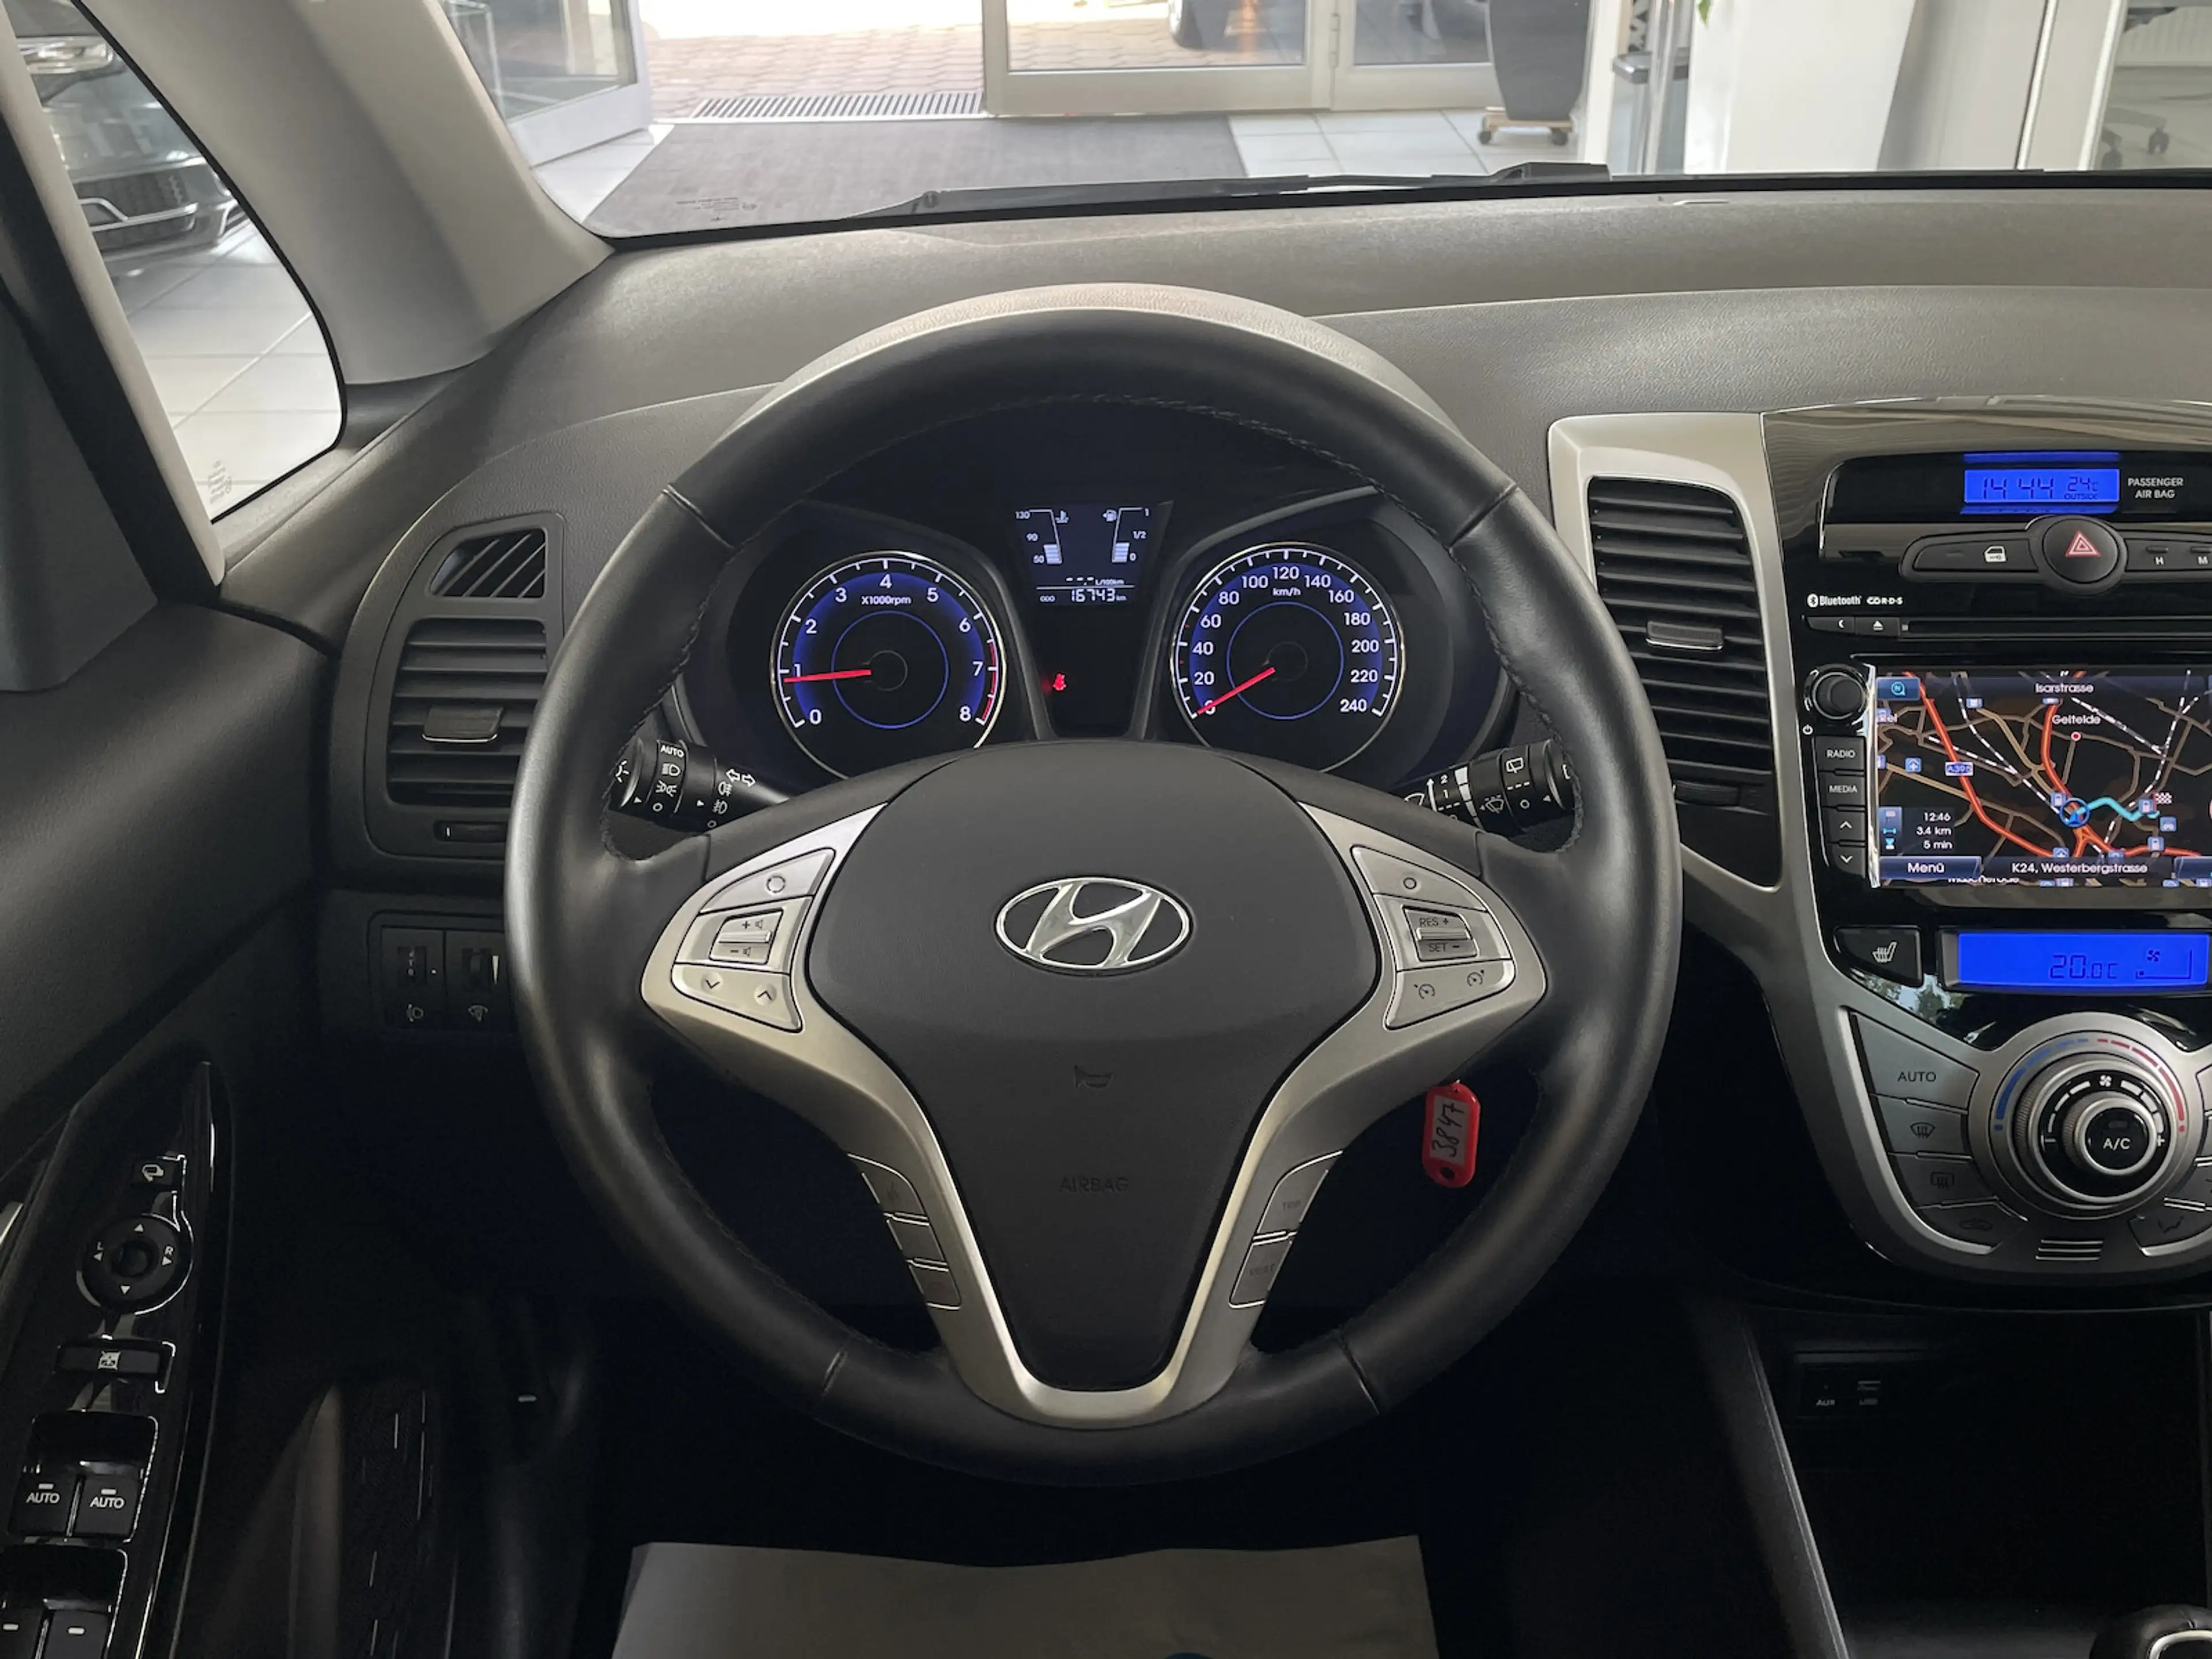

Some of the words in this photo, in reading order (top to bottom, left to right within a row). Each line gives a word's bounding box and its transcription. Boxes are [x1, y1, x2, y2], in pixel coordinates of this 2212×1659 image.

[2128, 478, 2184, 487] PASSENGER
[2135, 490, 2152, 498] AIR
[2154, 490, 2175, 498] BAG
[1133, 531, 1146, 539] 1/2
[2155, 556, 2164, 565] H
[2198, 556, 2209, 565] M
[1272, 566, 1300, 579] 120
[879, 575, 892, 588] 4
[1241, 575, 1268, 589] 100
[1304, 575, 1331, 588] 140
[835, 588, 847, 602] 3
[927, 588, 938, 602] 5
[1071, 589, 1115, 602] 16743
[1218, 591, 1240, 605] 80
[1272, 588, 1301, 597] km/h
[1328, 589, 1354, 603] 160
[861, 596, 911, 606] X1000rpm
[1819, 596, 1861, 605] Bluetooth
[959, 618, 971, 632] 6
[1200, 614, 1222, 628] 60
[1344, 612, 1370, 626] 180
[805, 619, 817, 634] 2
[1193, 641, 1214, 655] 40
[1351, 639, 1379, 653] 200
[794, 664, 801, 677] 1
[972, 661, 984, 676] 7
[1194, 671, 1215, 685] 20
[1350, 669, 1378, 683] 220
[2036, 683, 2093, 693] Isarstrasse
[1340, 699, 1367, 712] 240
[809, 709, 822, 724] 0
[959, 706, 972, 721] 8
[661, 745, 684, 758] AUTO
[1827, 749, 1856, 759] RADIO
[1440, 775, 1448, 784] 2
[1444, 789, 1449, 798] 1
[1829, 785, 1858, 794] MEDIA
[1923, 812, 1950, 822] 12:46
[1917, 826, 1933, 836] 3.4
[1936, 826, 1952, 836] km
[1924, 840, 1930, 850] 5
[1933, 840, 1952, 850] min
[1908, 861, 1944, 873] Menü
[2012, 862, 2039, 874] K24,
[2041, 862, 2147, 875] Westerbergstrasse
[1419, 916, 1439, 927] RES
[1429, 942, 1448, 953] SET
[1897, 1071, 1937, 1082] AUTO
[1431, 1102, 1465, 1158] 3847
[2103, 1138, 2131, 1150] A/C
[1060, 1177, 1130, 1192] AIRBAG
[96, 1242, 104, 1250] L
[165, 1245, 173, 1256] R
[26, 1492, 60, 1505] AUTO
[89, 1496, 125, 1510] AUTO
